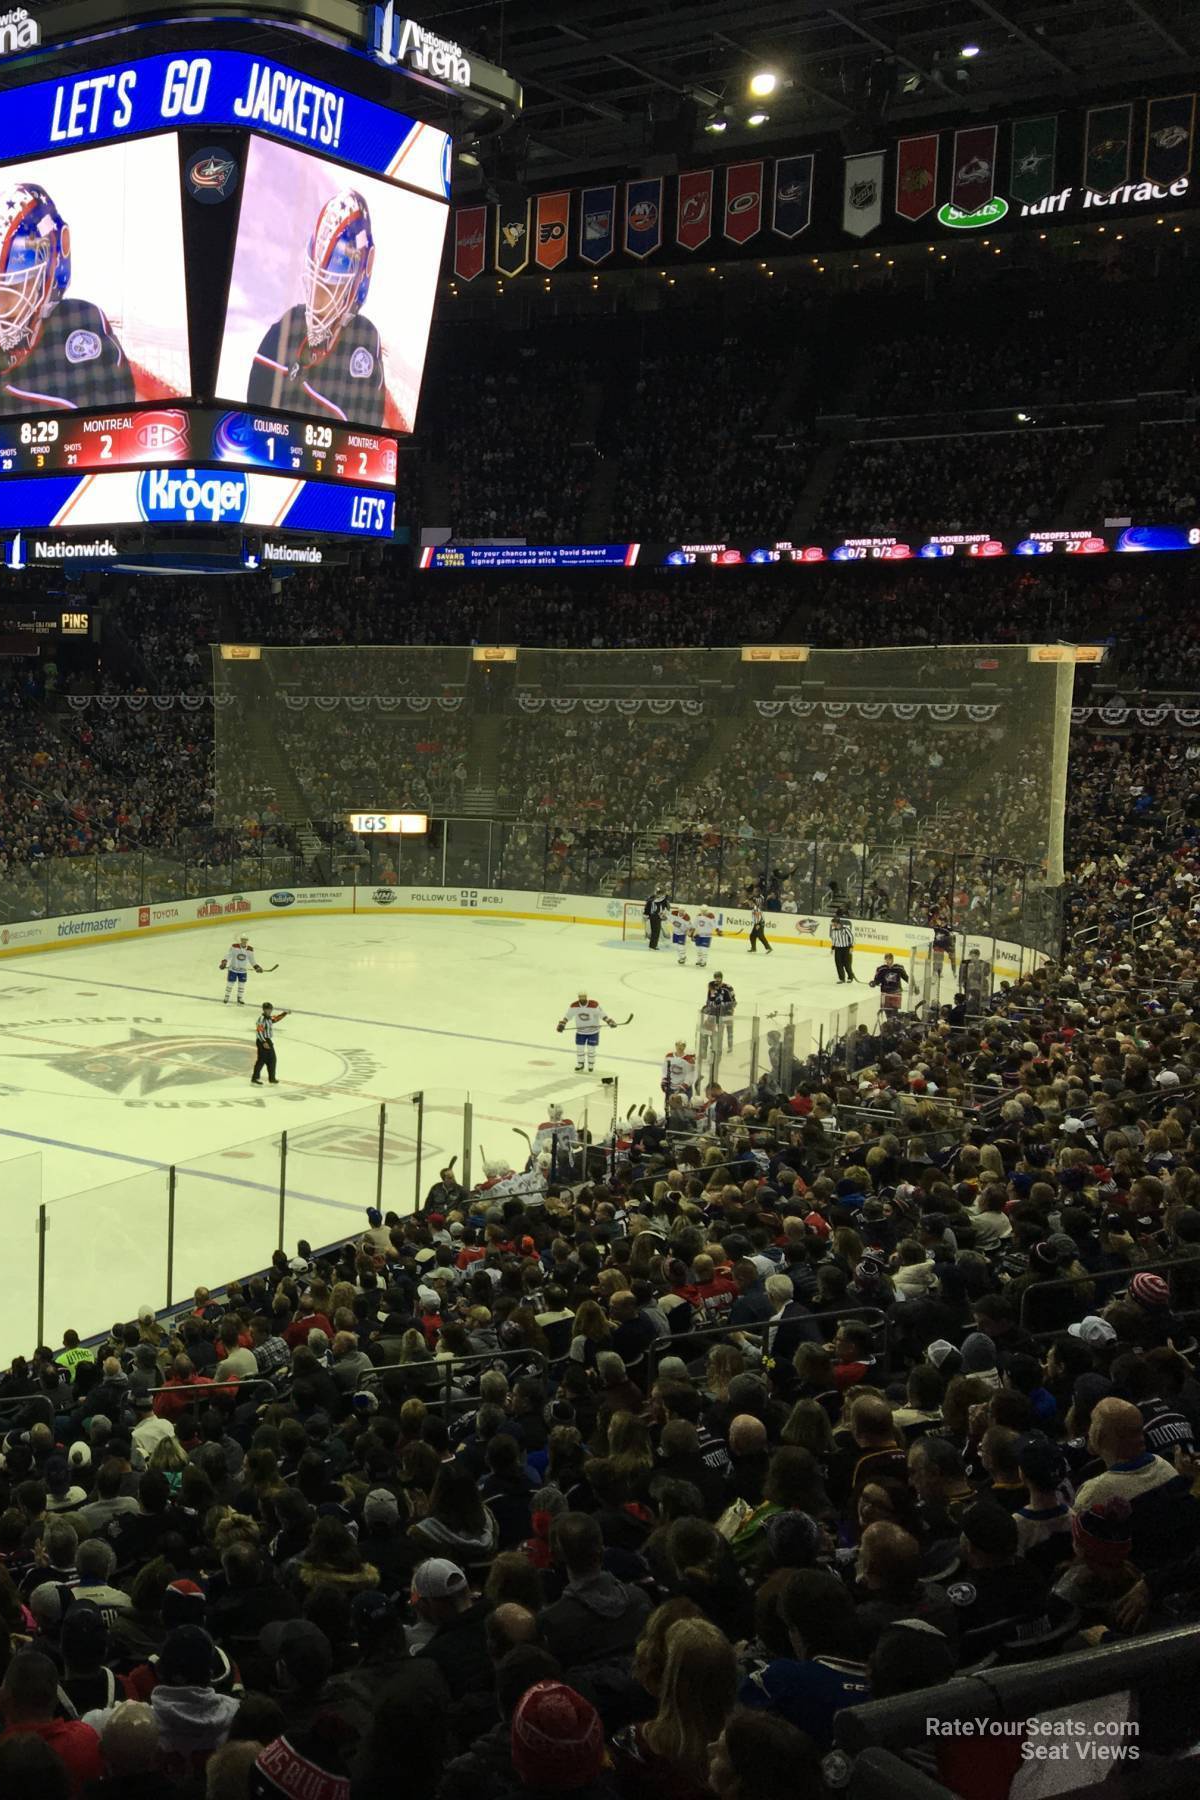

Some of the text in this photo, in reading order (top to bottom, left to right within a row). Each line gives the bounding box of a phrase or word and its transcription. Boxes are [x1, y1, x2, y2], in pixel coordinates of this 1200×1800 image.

[417, 26, 463, 58] Nationwide
[398, 19, 471, 87] Arena
[50, 58, 345, 149] LET'S GO JACKETS!
[20, 420, 59, 444] 8:29
[83, 418, 134, 433] MONTREAL
[253, 418, 290, 436] COLUMBUS
[305, 424, 333, 448] 8:29
[347, 435, 380, 450] MONTREAL
[0, 448, 17, 457] SHOTS
[30, 446, 50, 454] PERIOD
[64, 443, 82, 453] SHOTS
[100, 434, 113, 459] 2
[266, 437, 276, 462] 1
[37, 455, 45, 467] 3
[67, 454, 77, 465] 21
[315, 460, 323, 472] 3
[358, 452, 369, 475] 2
[148, 469, 246, 521] Kroger
[351, 495, 385, 530] LET'S
[930, 534, 991, 543] BLOCKED SHOTS
[1030, 531, 1092, 540] FACEOFFS WON
[35, 540, 117, 558] Nationwide
[848, 547, 892, 558] 0/2 0/2
[941, 544, 978, 555] 10 6
[1039, 541, 1081, 552] 26 27
[264, 544, 323, 564] Nationwide
[684, 553, 718, 563] 12 8
[768, 550, 802, 560] 16 13
[357, 816, 386, 830] IGS
[411, 893, 504, 904] FOLLOW US #CBJ
[152, 908, 179, 920] TOYOTA
[10, 929, 43, 939] SECURITY
[57, 918, 119, 937] ticketmaster
